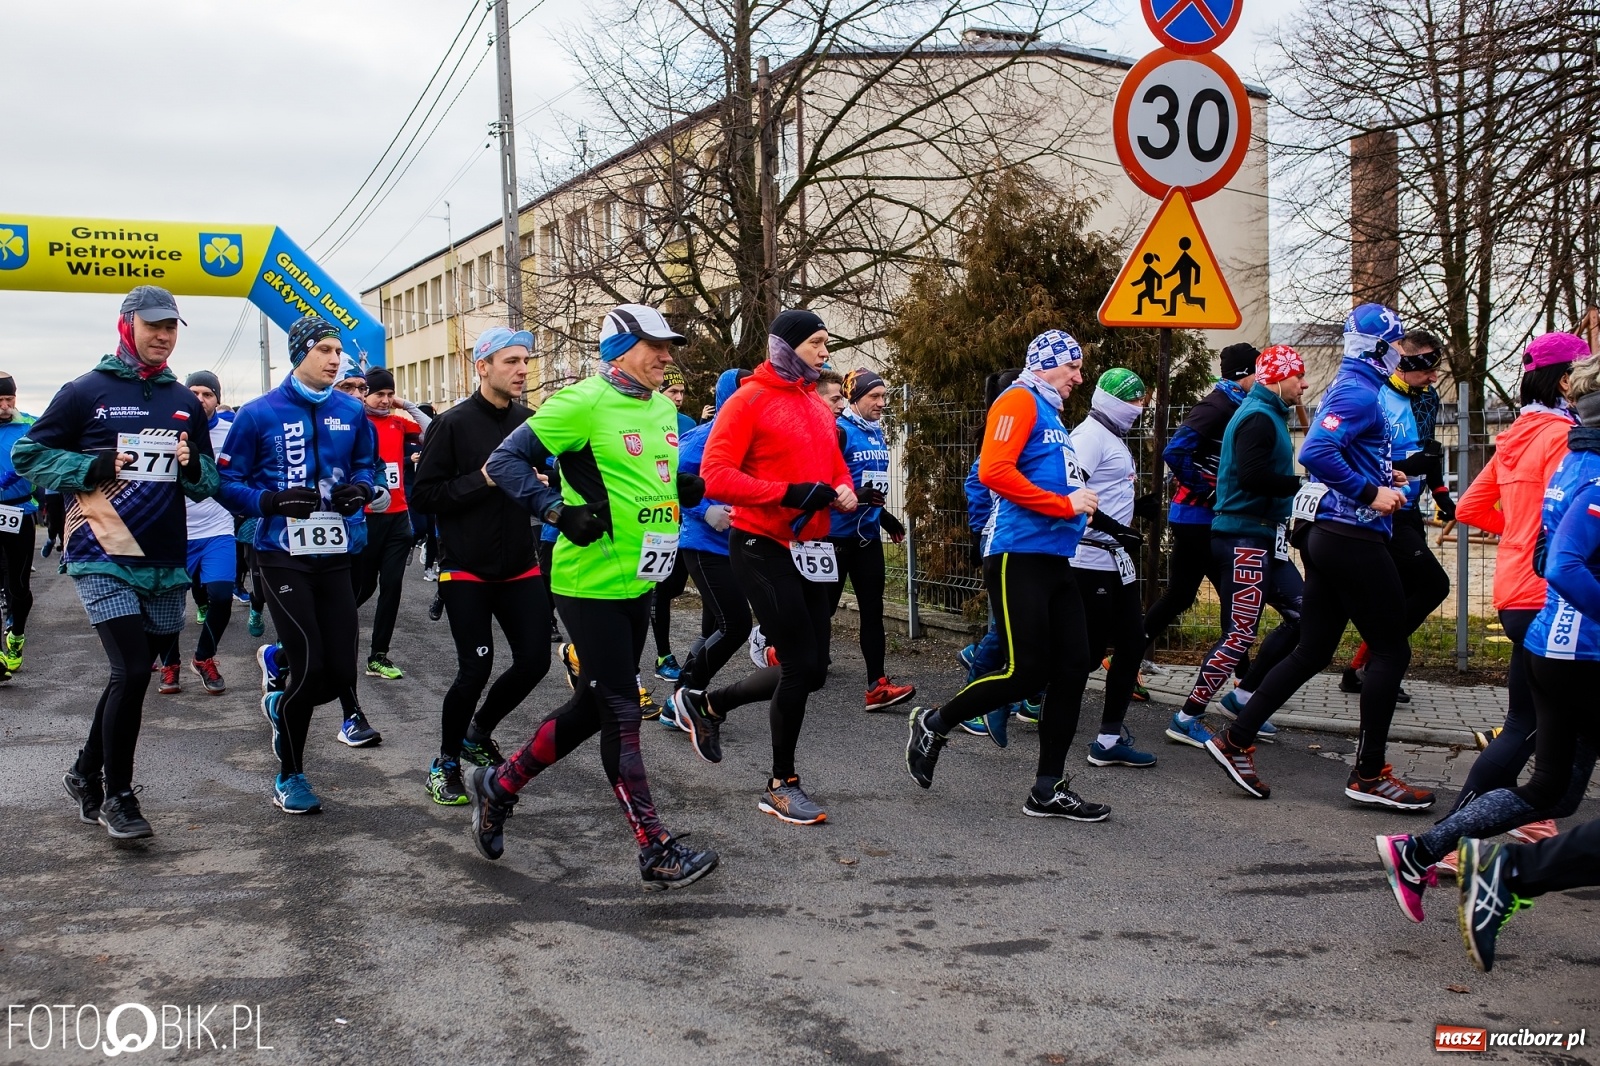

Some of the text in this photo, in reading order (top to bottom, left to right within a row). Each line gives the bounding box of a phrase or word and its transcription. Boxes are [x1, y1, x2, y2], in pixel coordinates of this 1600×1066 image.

[1137, 84, 1229, 163] 30
[71, 226, 159, 242] Gmina
[48, 241, 183, 261] Pietrowice
[66, 261, 166, 279] Wielkie
[262, 270, 321, 317] aktywn
[276, 252, 359, 330] Gmina ludzi
[121, 450, 175, 473] 277
[388, 472, 398, 484] 5
[1295, 493, 1319, 514] 176
[293, 526, 344, 547] 183
[795, 553, 834, 574] 159
[1188, 547, 1268, 706] IRON MAIDEN
